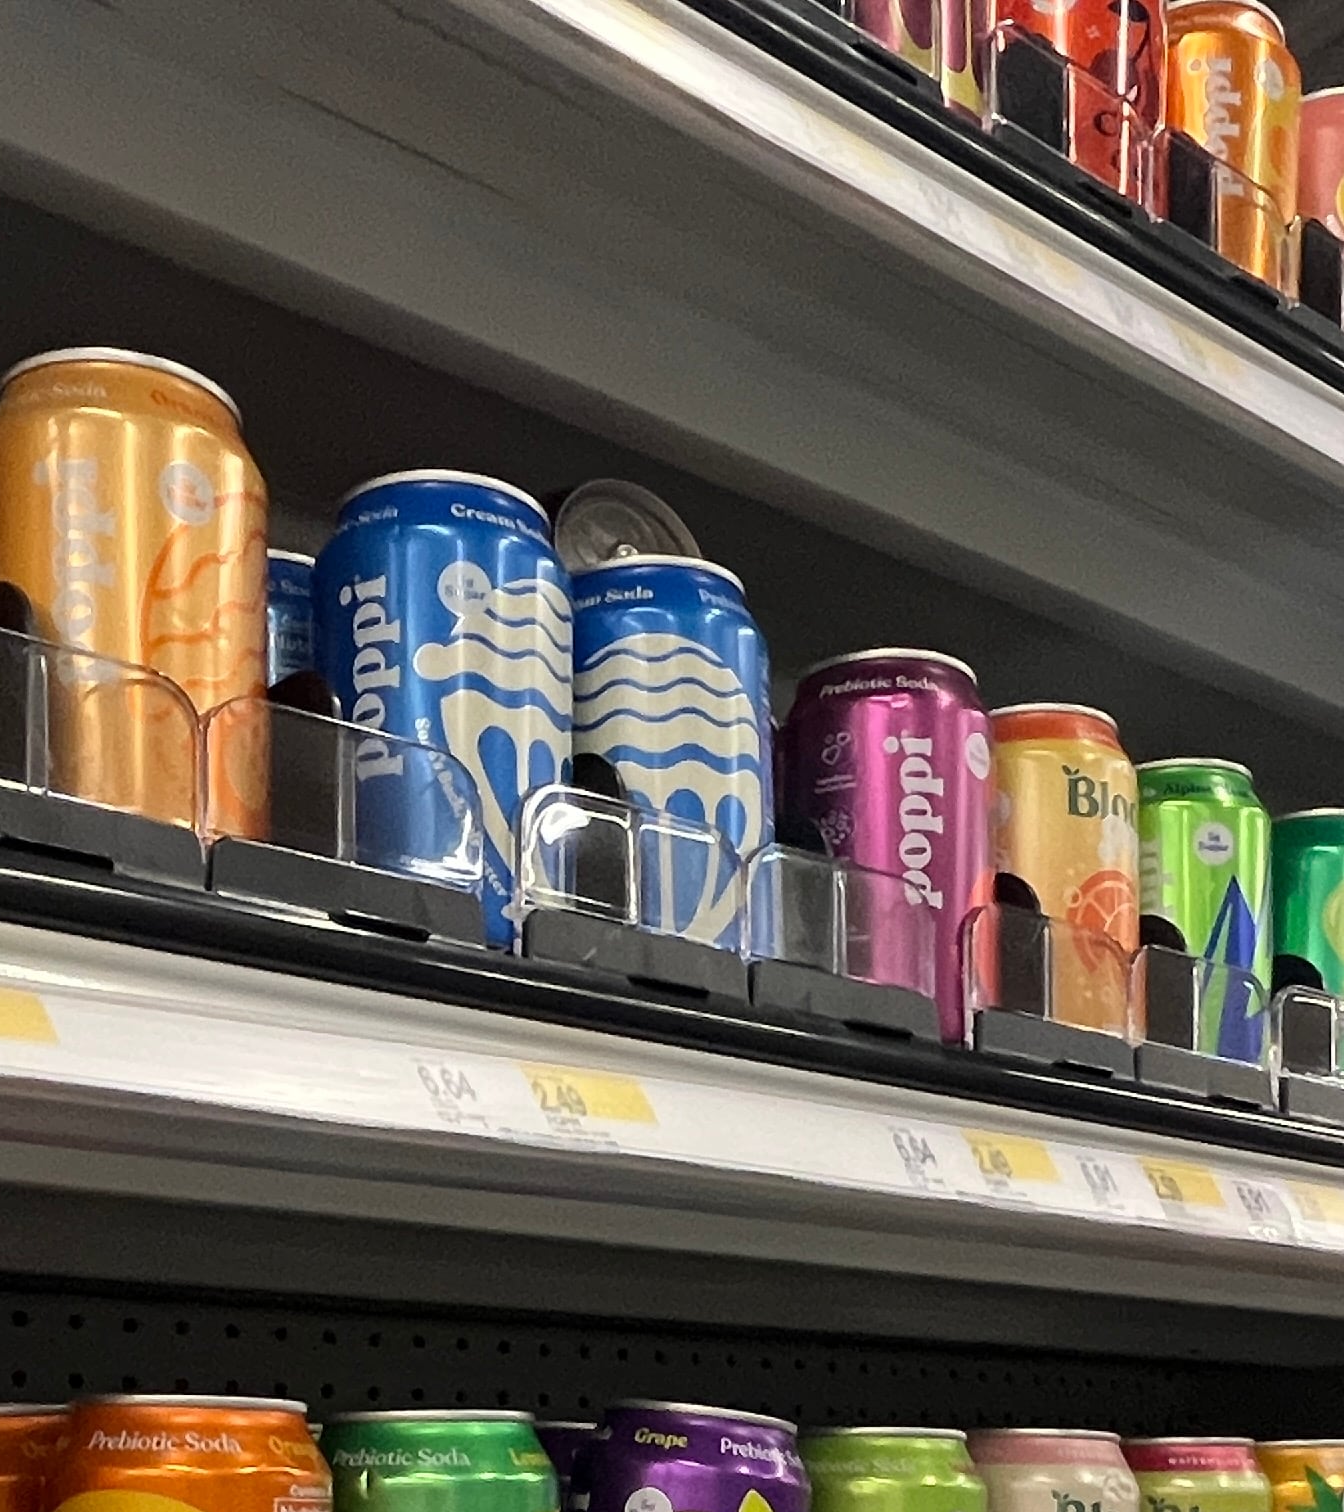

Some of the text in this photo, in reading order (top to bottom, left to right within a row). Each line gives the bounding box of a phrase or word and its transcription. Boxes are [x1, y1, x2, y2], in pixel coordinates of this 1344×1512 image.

[450, 503, 515, 529] Cream
[340, 574, 405, 782] poppi
[819, 677, 893, 699] Prebiotic
[882, 732, 946, 910] poppi
[416, 1063, 479, 1103] 6.64
[531, 1079, 588, 1119] 2.49
[88, 1429, 244, 1456] Prebiotic Soda
[633, 1427, 689, 1452] Grape
[332, 1447, 472, 1469] Prebiotic Soda
